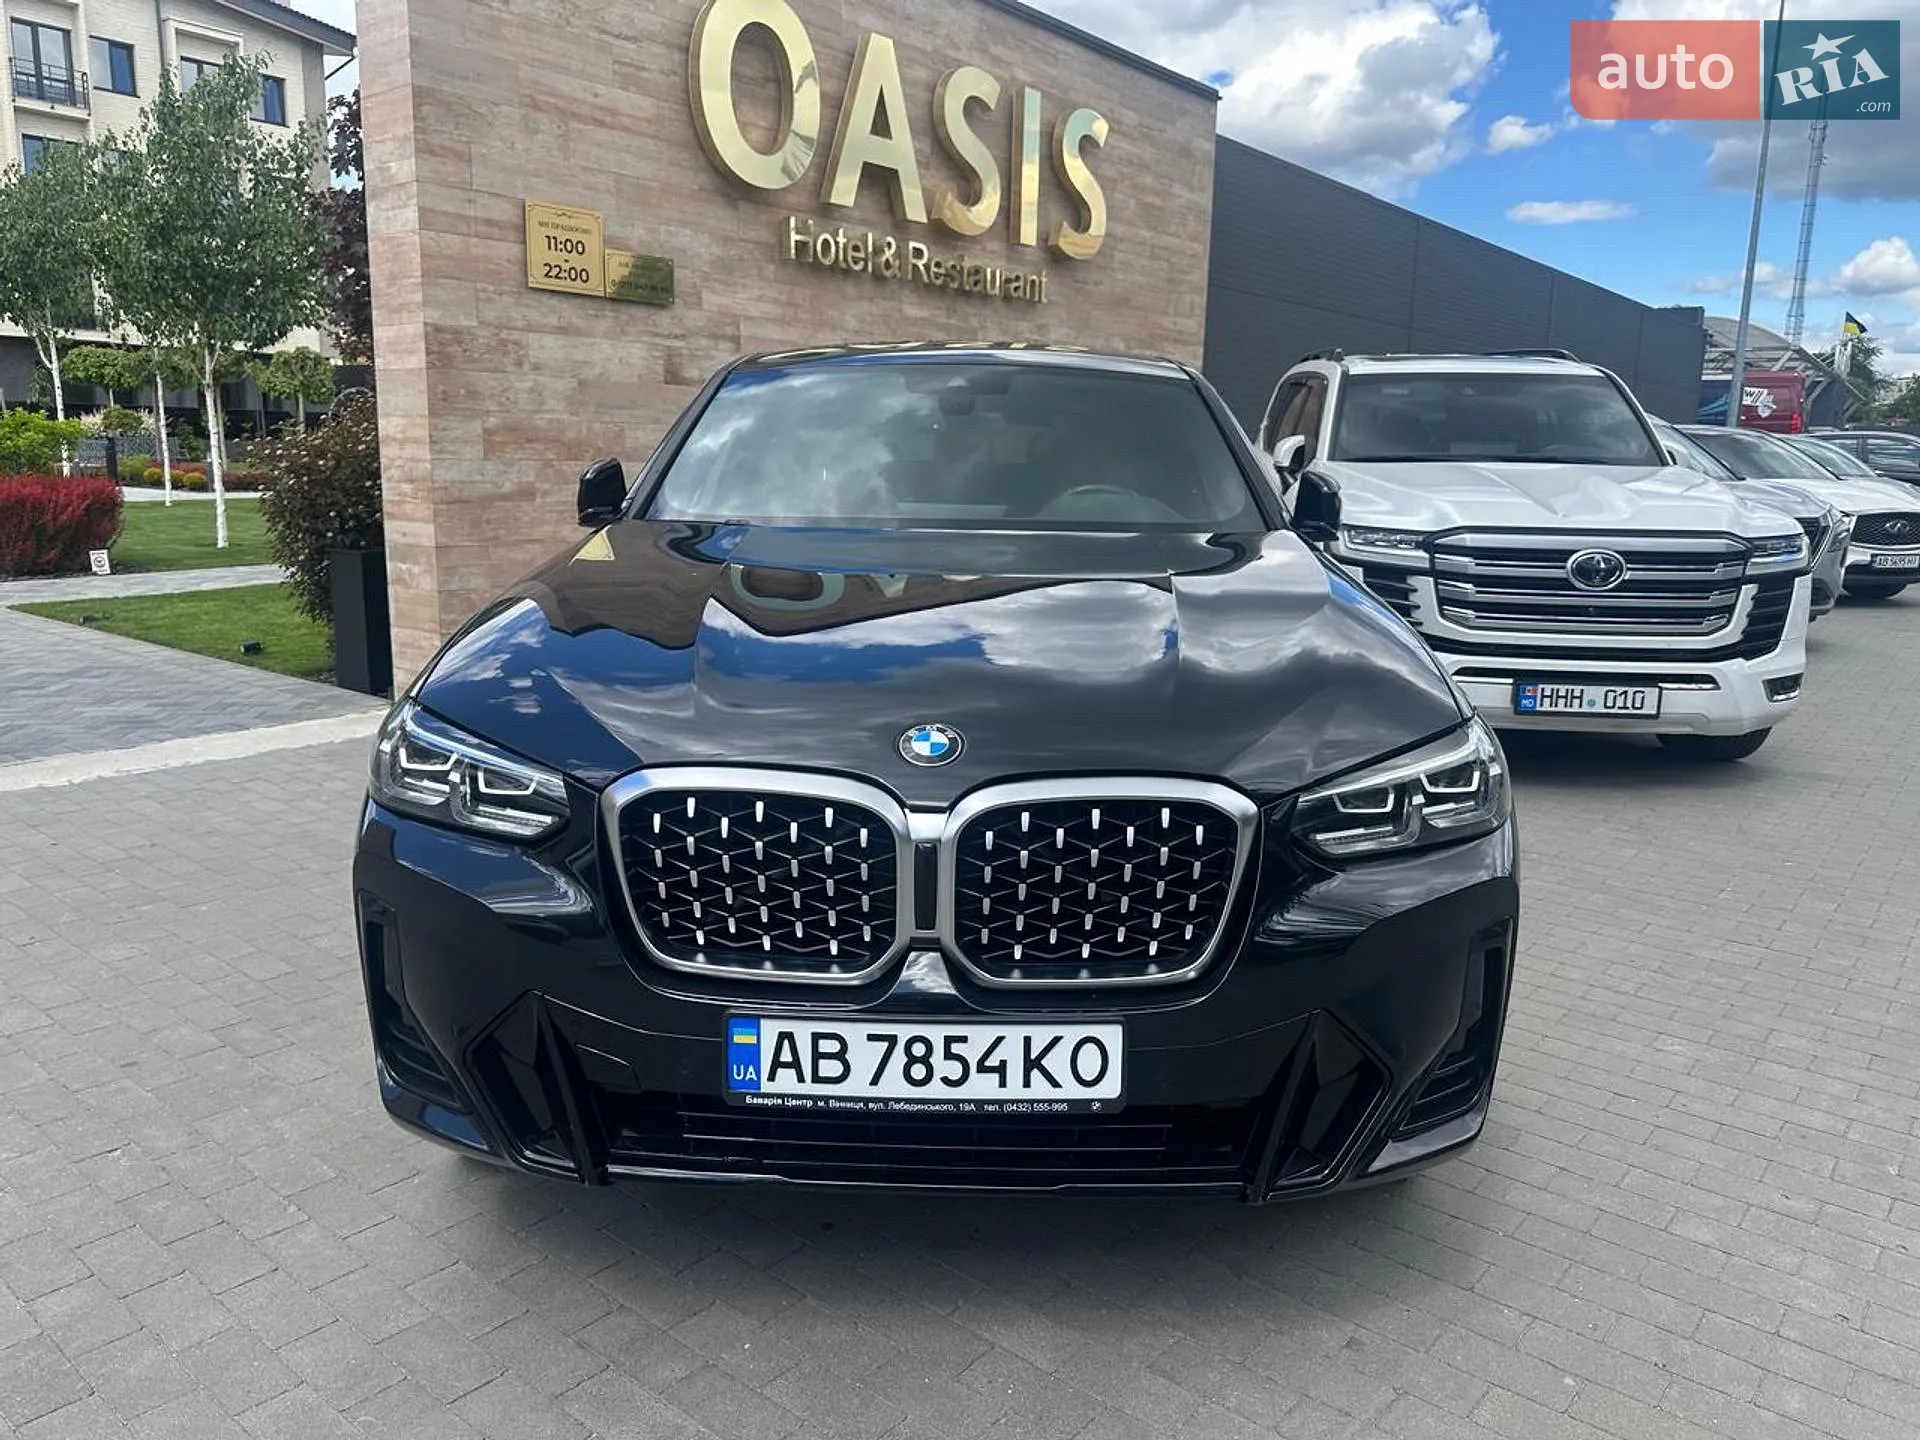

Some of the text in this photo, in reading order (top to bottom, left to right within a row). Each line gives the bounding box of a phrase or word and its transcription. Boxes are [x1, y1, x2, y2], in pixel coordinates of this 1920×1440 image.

[689, 0, 1109, 259] OASIS
[544, 235, 586, 255] 11:00
[787, 215, 1048, 303] Hotel & Restaurant
[543, 262, 590, 284] 22:00
[1521, 698, 1535, 708] MD
[1540, 687, 1646, 710] HHH 010
[766, 1030, 1110, 1089] AB 7854 KO
[733, 1064, 758, 1082] UA
[745, 1094, 783, 1107] Баварія
[784, 1097, 813, 1107] Центр
[1003, 1103, 1032, 1113] (0432)
